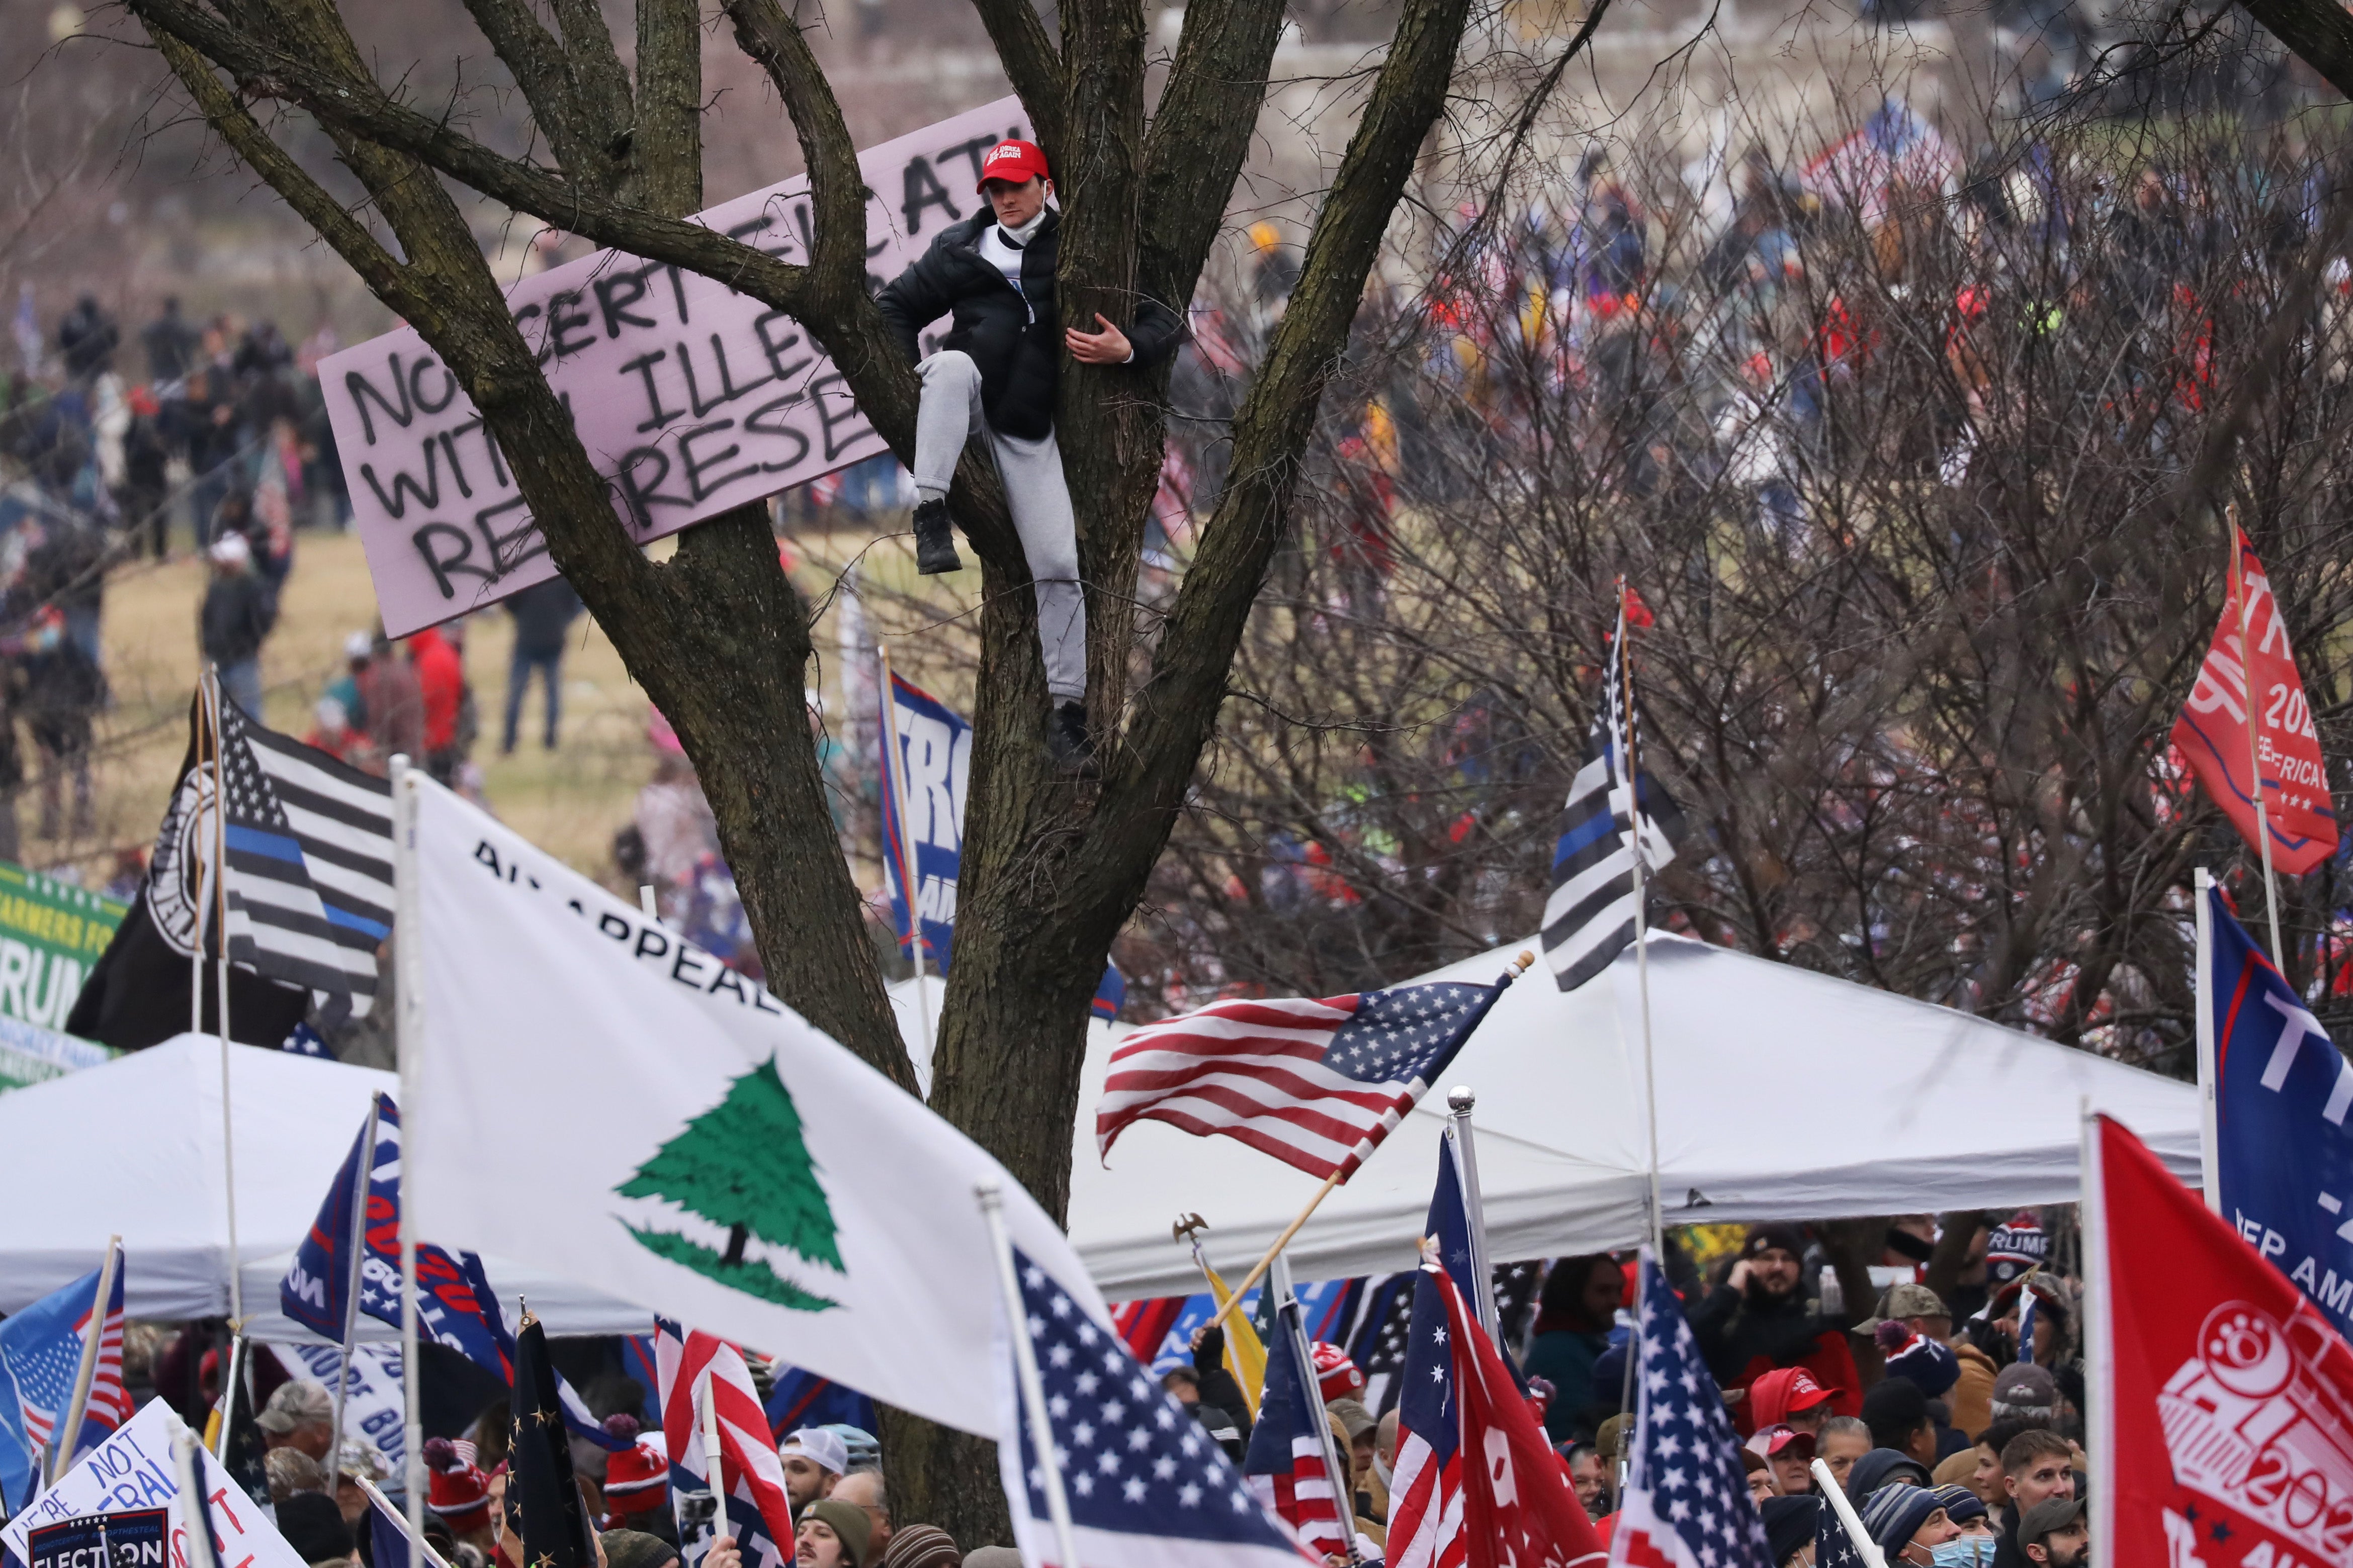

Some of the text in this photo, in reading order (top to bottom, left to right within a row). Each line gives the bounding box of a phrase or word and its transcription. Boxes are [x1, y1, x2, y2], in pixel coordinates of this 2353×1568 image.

[412, 371, 878, 599] RERESE
[0, 934, 95, 1033] RUM
[568, 898, 782, 1017] PPEAL
[2290, 1255, 2353, 1317] AM
[87, 1427, 145, 1490] NOT
[34, 1539, 162, 1568] ELECTON
[91, 1524, 160, 1540] #SOPTHESTEAL
